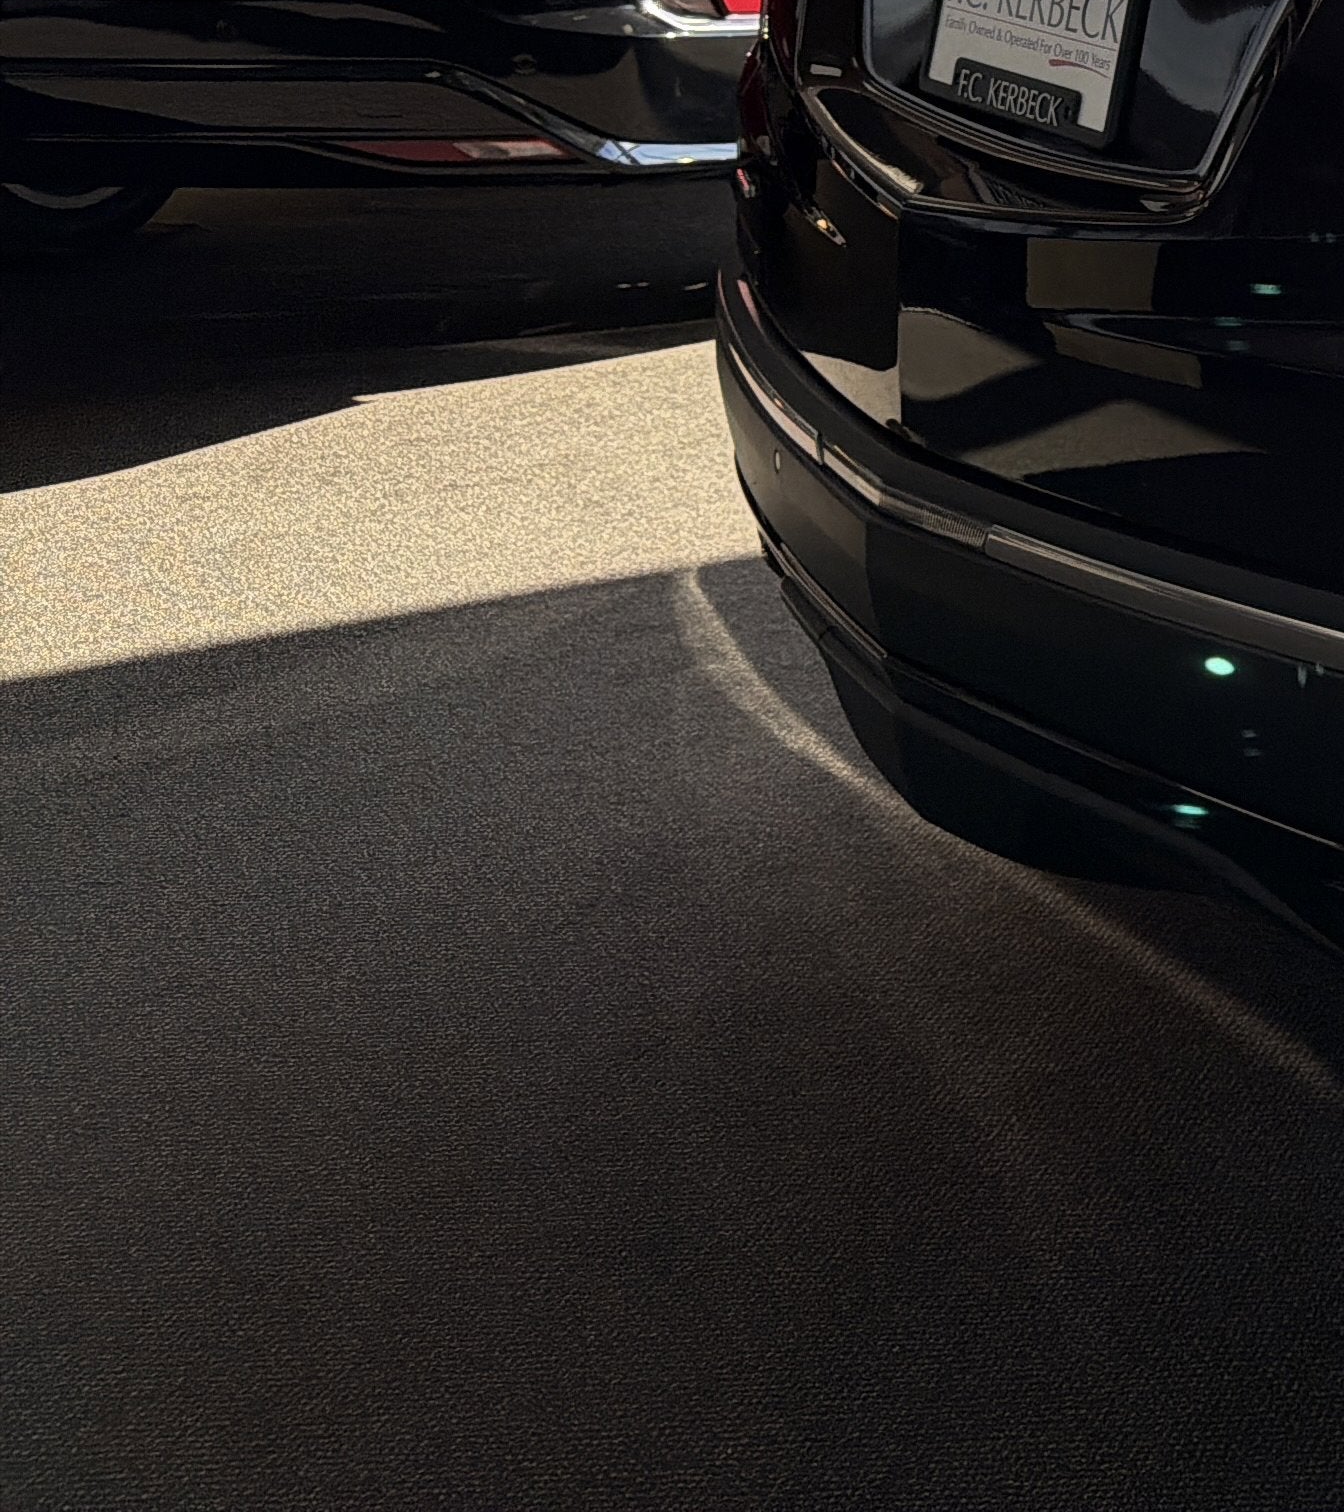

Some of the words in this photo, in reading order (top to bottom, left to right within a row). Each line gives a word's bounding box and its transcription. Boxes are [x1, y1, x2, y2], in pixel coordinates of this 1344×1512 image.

[1005, 30, 1039, 52] Operated
[1040, 40, 1052, 55] For
[1053, 44, 1073, 60] Over
[1074, 50, 1089, 65] 100
[1091, 52, 1112, 71] Years
[957, 68, 983, 103] F.C.
[987, 78, 1063, 127] KERBECK
